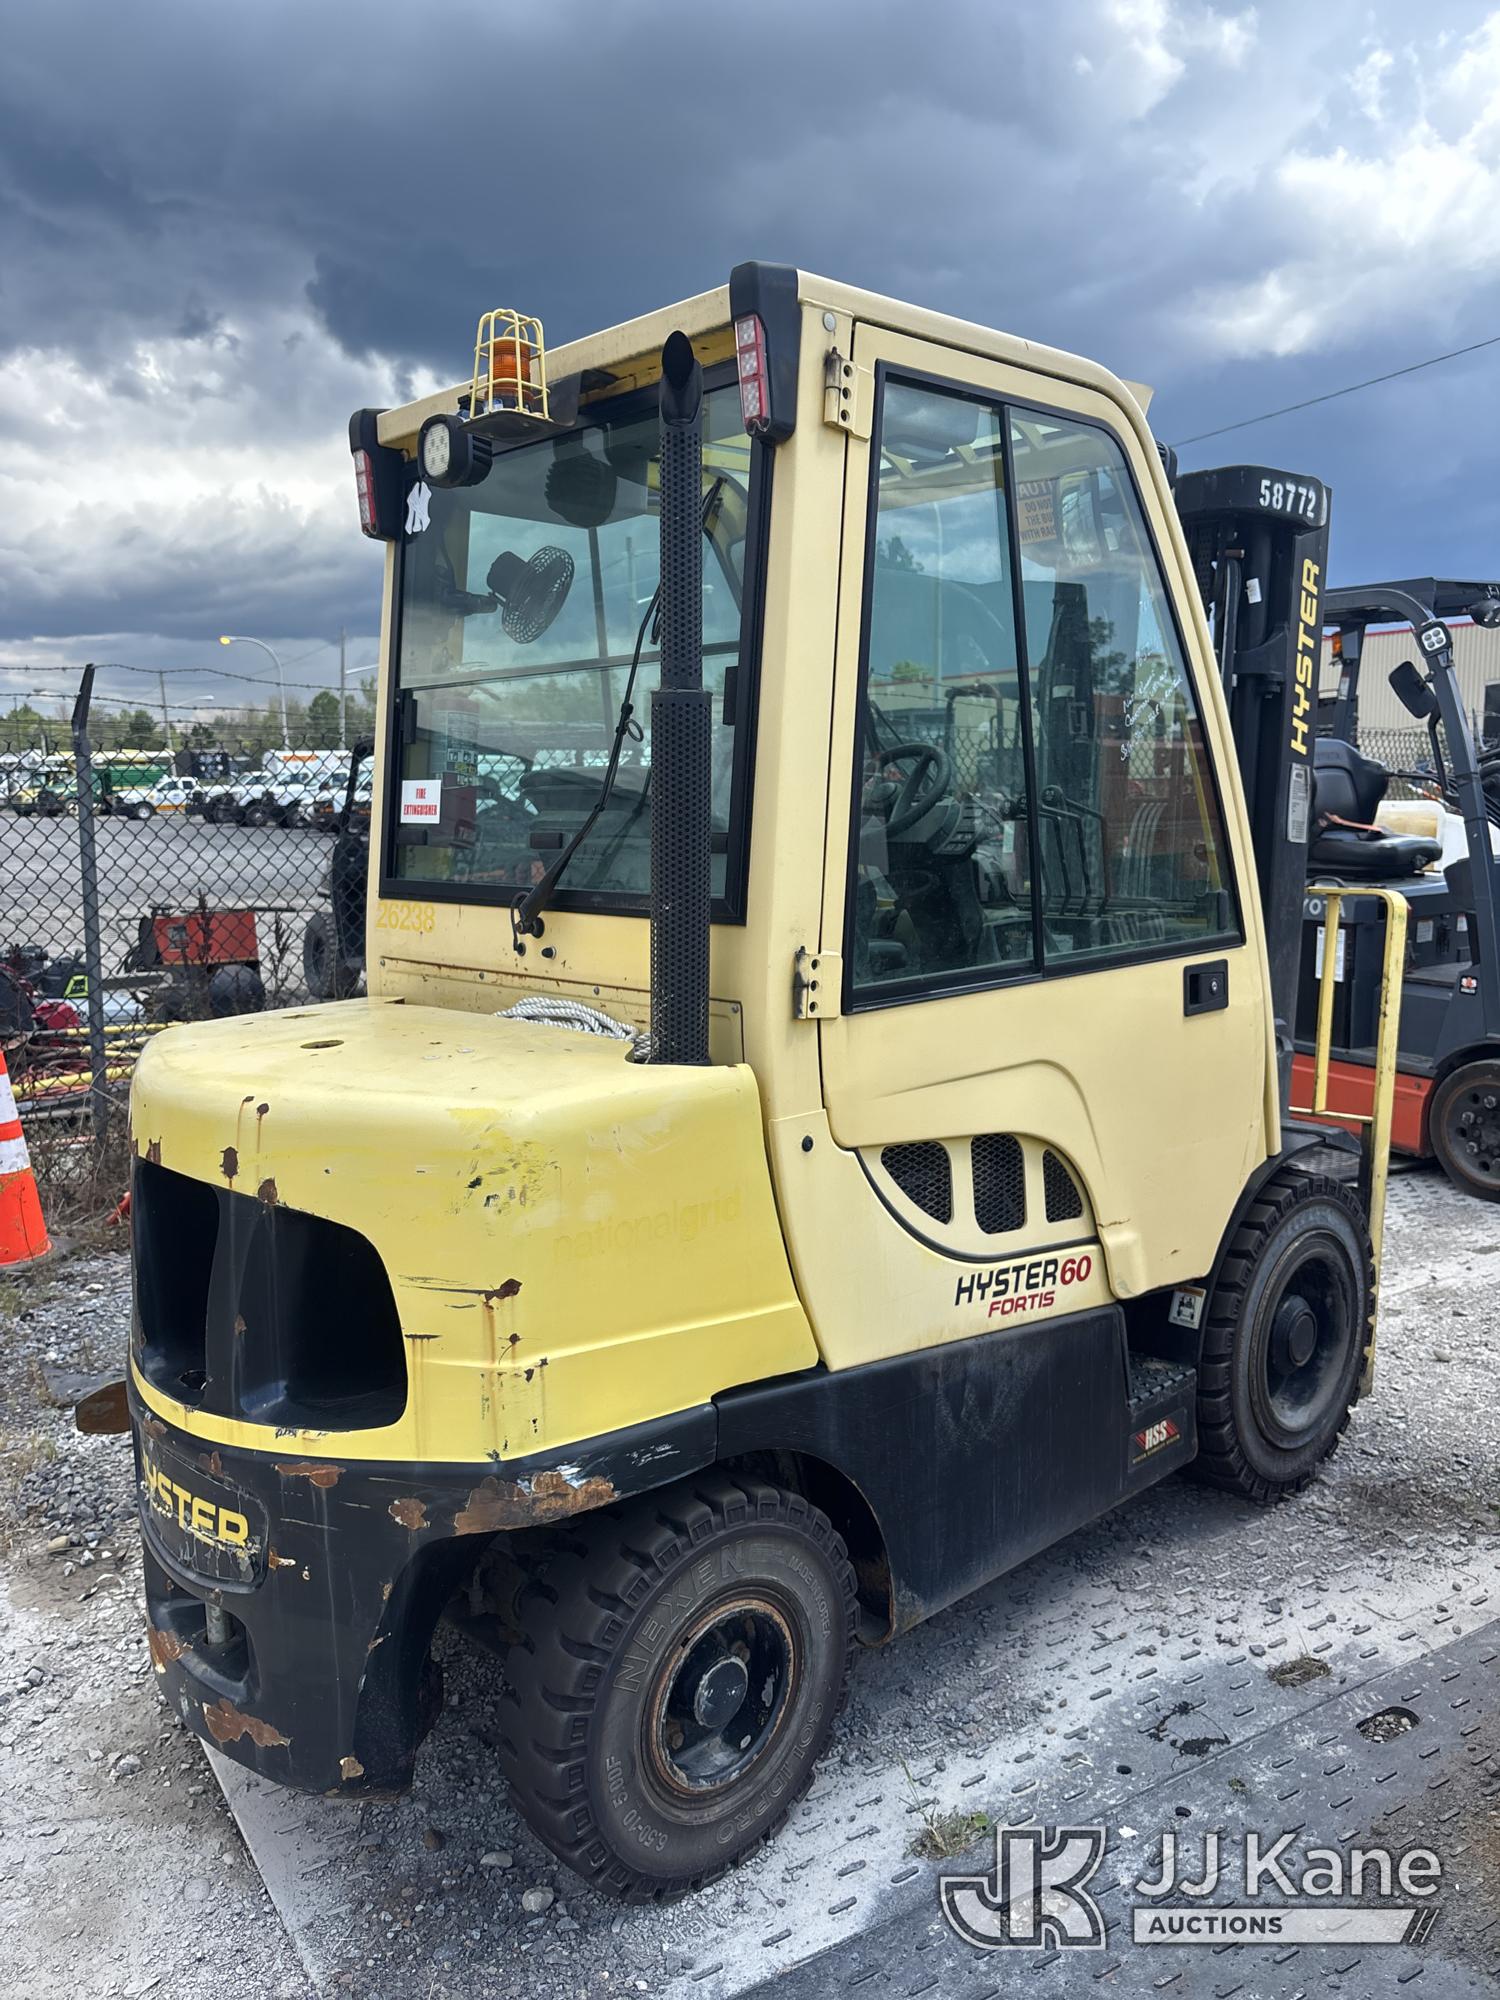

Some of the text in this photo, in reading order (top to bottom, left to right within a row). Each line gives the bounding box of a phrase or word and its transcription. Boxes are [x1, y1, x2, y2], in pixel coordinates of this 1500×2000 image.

[1259, 479, 1316, 518] 58772
[1291, 558, 1320, 756] HYSTER
[376, 901, 436, 933] 26238
[988, 1290, 1056, 1318] FORTIS
[1145, 1420, 1167, 1450] HSS
[613, 1540, 745, 1694] NEXEN
[788, 1555, 815, 1586] MADE
[815, 1593, 831, 1640] KOREA
[623, 1808, 669, 1851] 6.50-10
